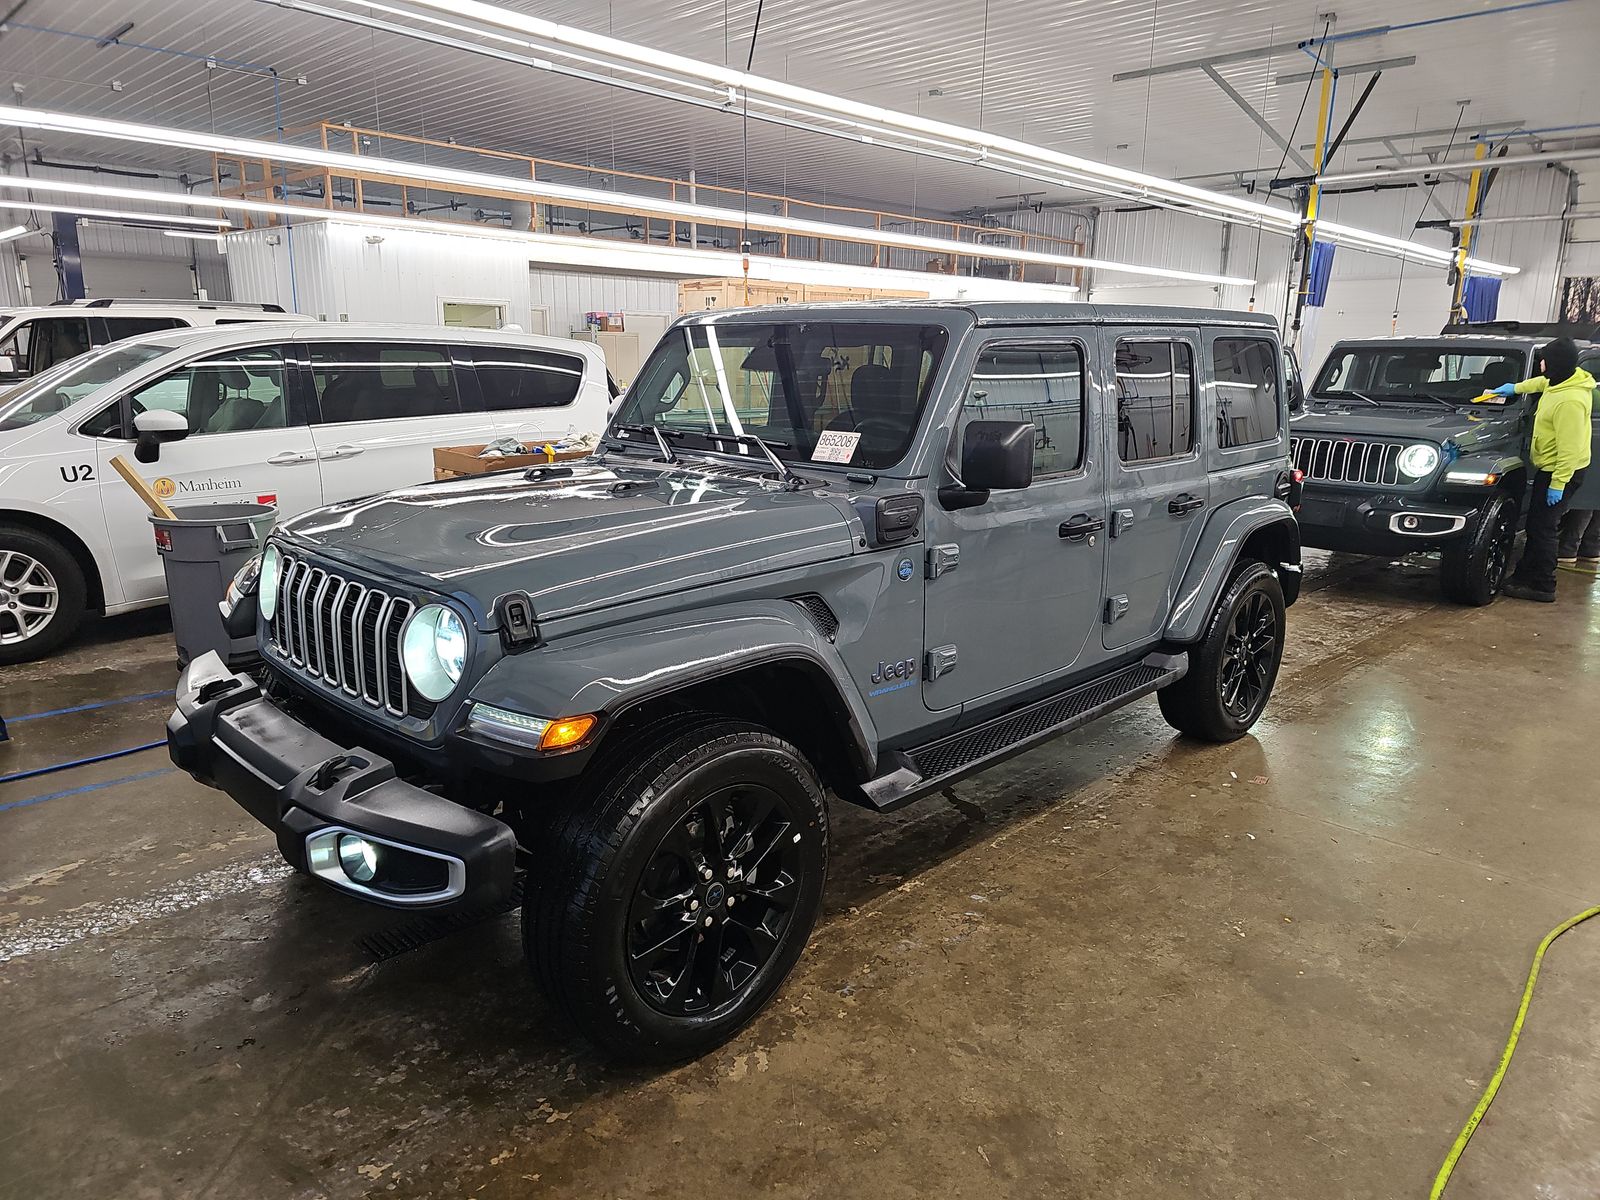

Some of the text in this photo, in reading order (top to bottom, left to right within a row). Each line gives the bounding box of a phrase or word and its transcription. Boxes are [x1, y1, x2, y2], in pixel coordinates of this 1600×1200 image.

[820, 434, 860, 448] 8652087
[60, 464, 95, 482] U2
[179, 477, 242, 493] Manheim
[871, 657, 915, 684] Jeep
